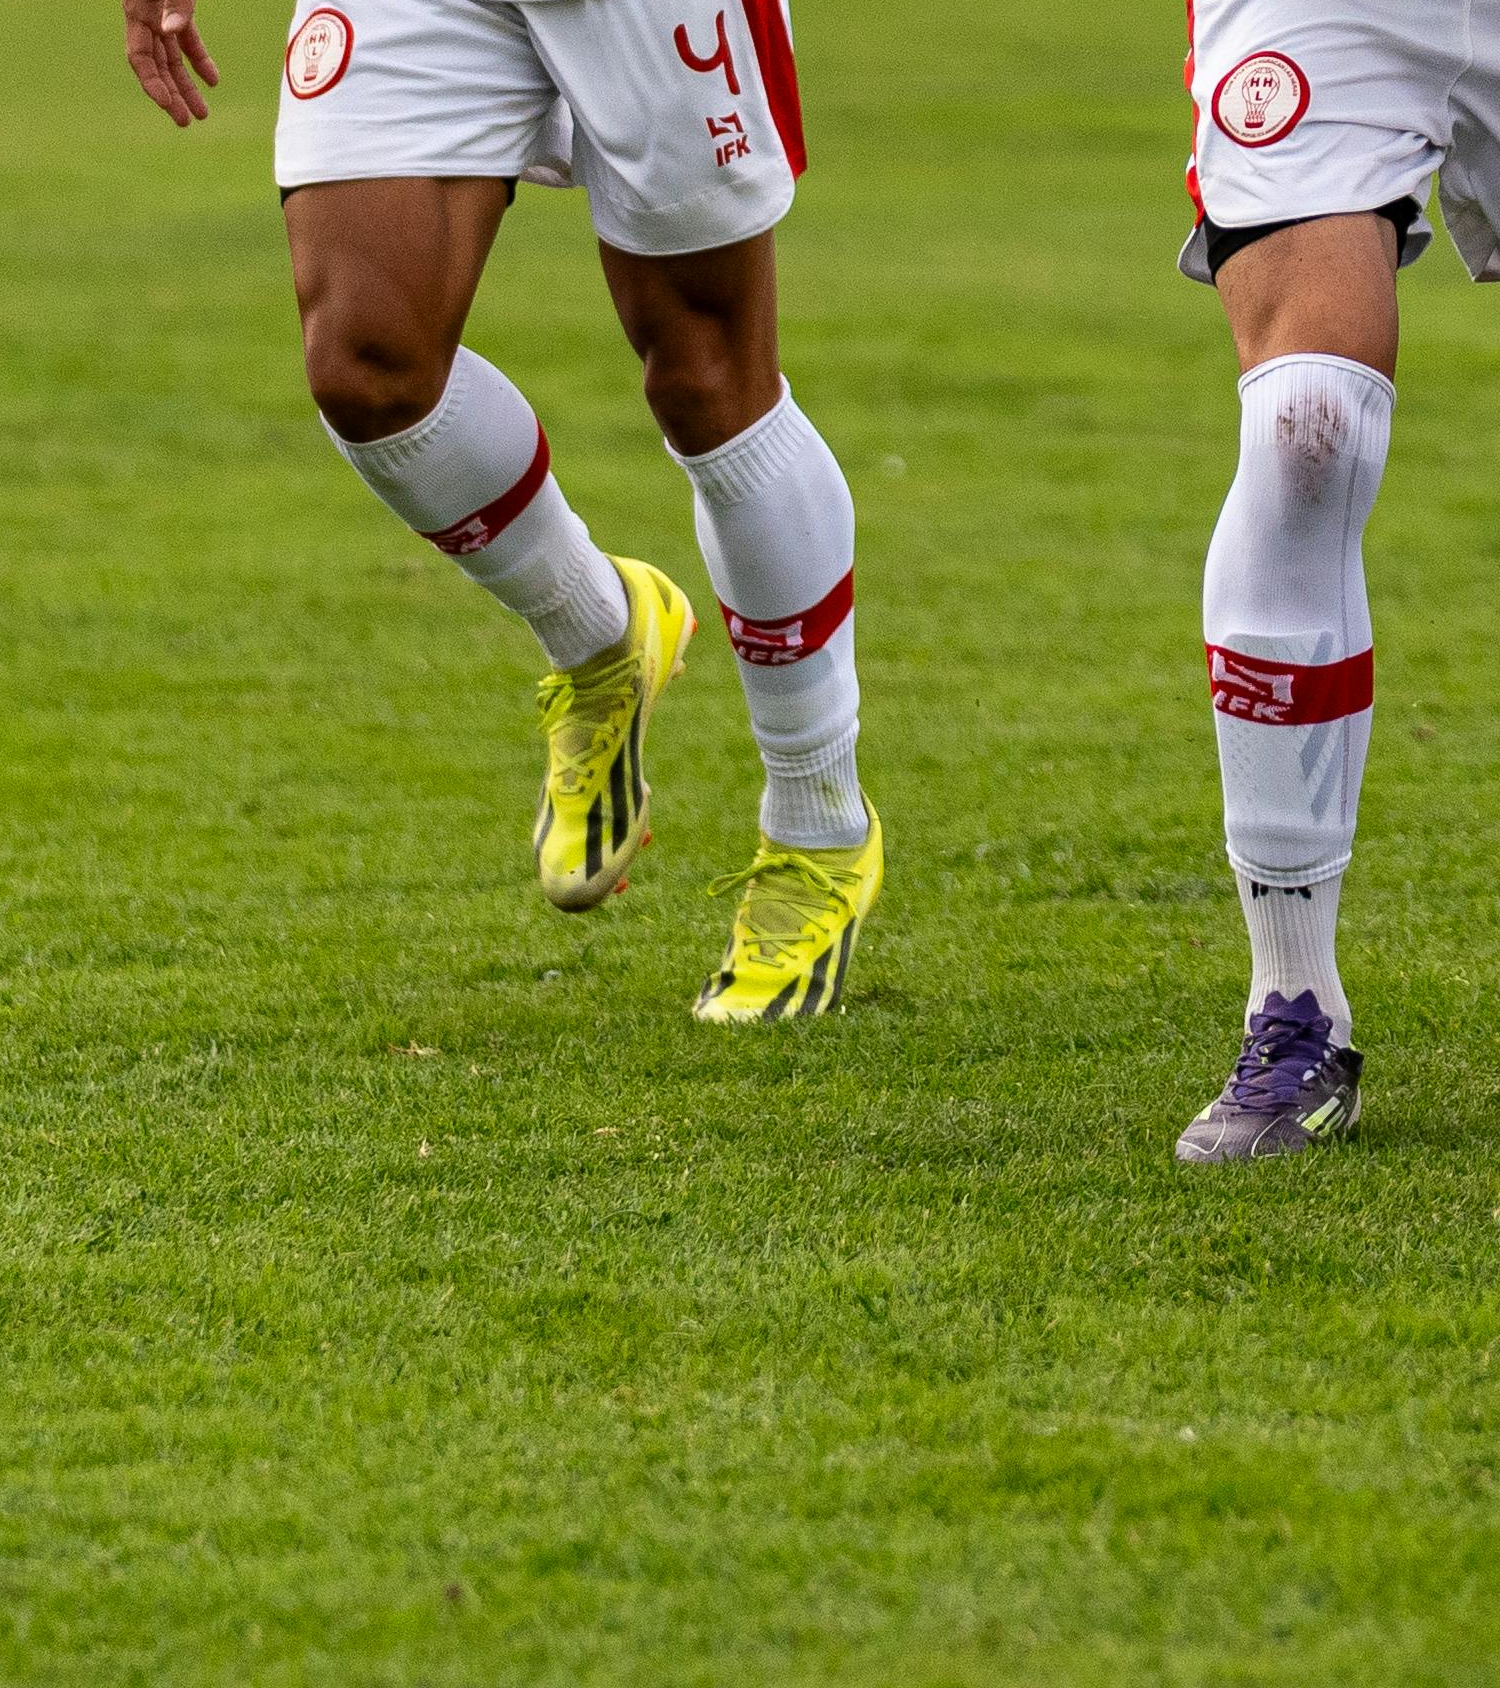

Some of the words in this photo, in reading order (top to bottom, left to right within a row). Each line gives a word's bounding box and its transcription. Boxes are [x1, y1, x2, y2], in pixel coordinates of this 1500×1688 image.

[673, 9, 741, 96] 4
[715, 134, 752, 168] IFK
[1213, 688, 1291, 722] IFK
